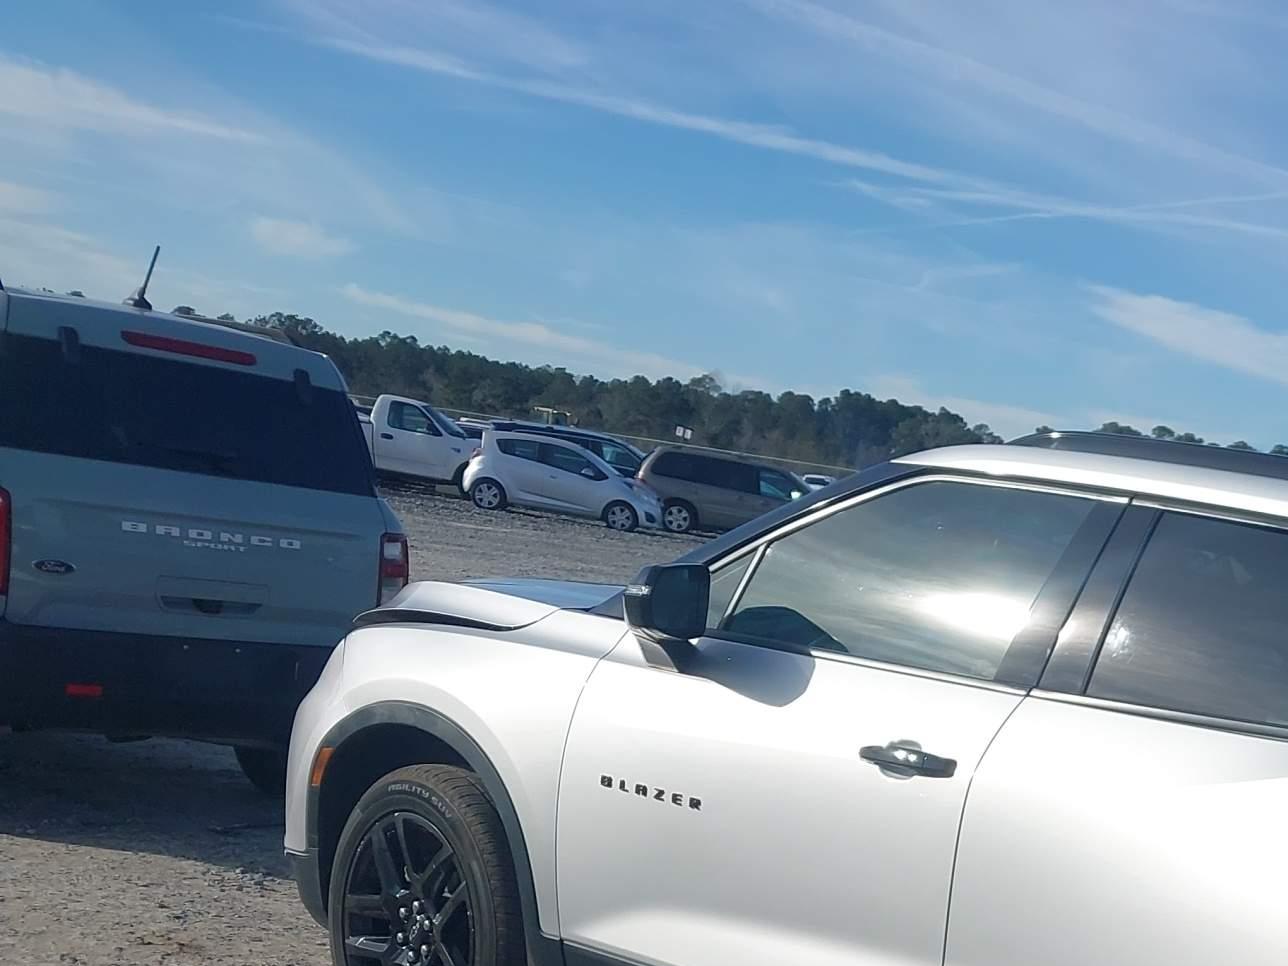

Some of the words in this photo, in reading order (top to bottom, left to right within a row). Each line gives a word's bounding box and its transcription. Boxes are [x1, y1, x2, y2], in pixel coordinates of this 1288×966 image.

[121, 520, 302, 550] BRONCO
[183, 540, 248, 553] SPORT
[600, 775, 702, 811] BLAZER
[431, 796, 452, 818] SUV
